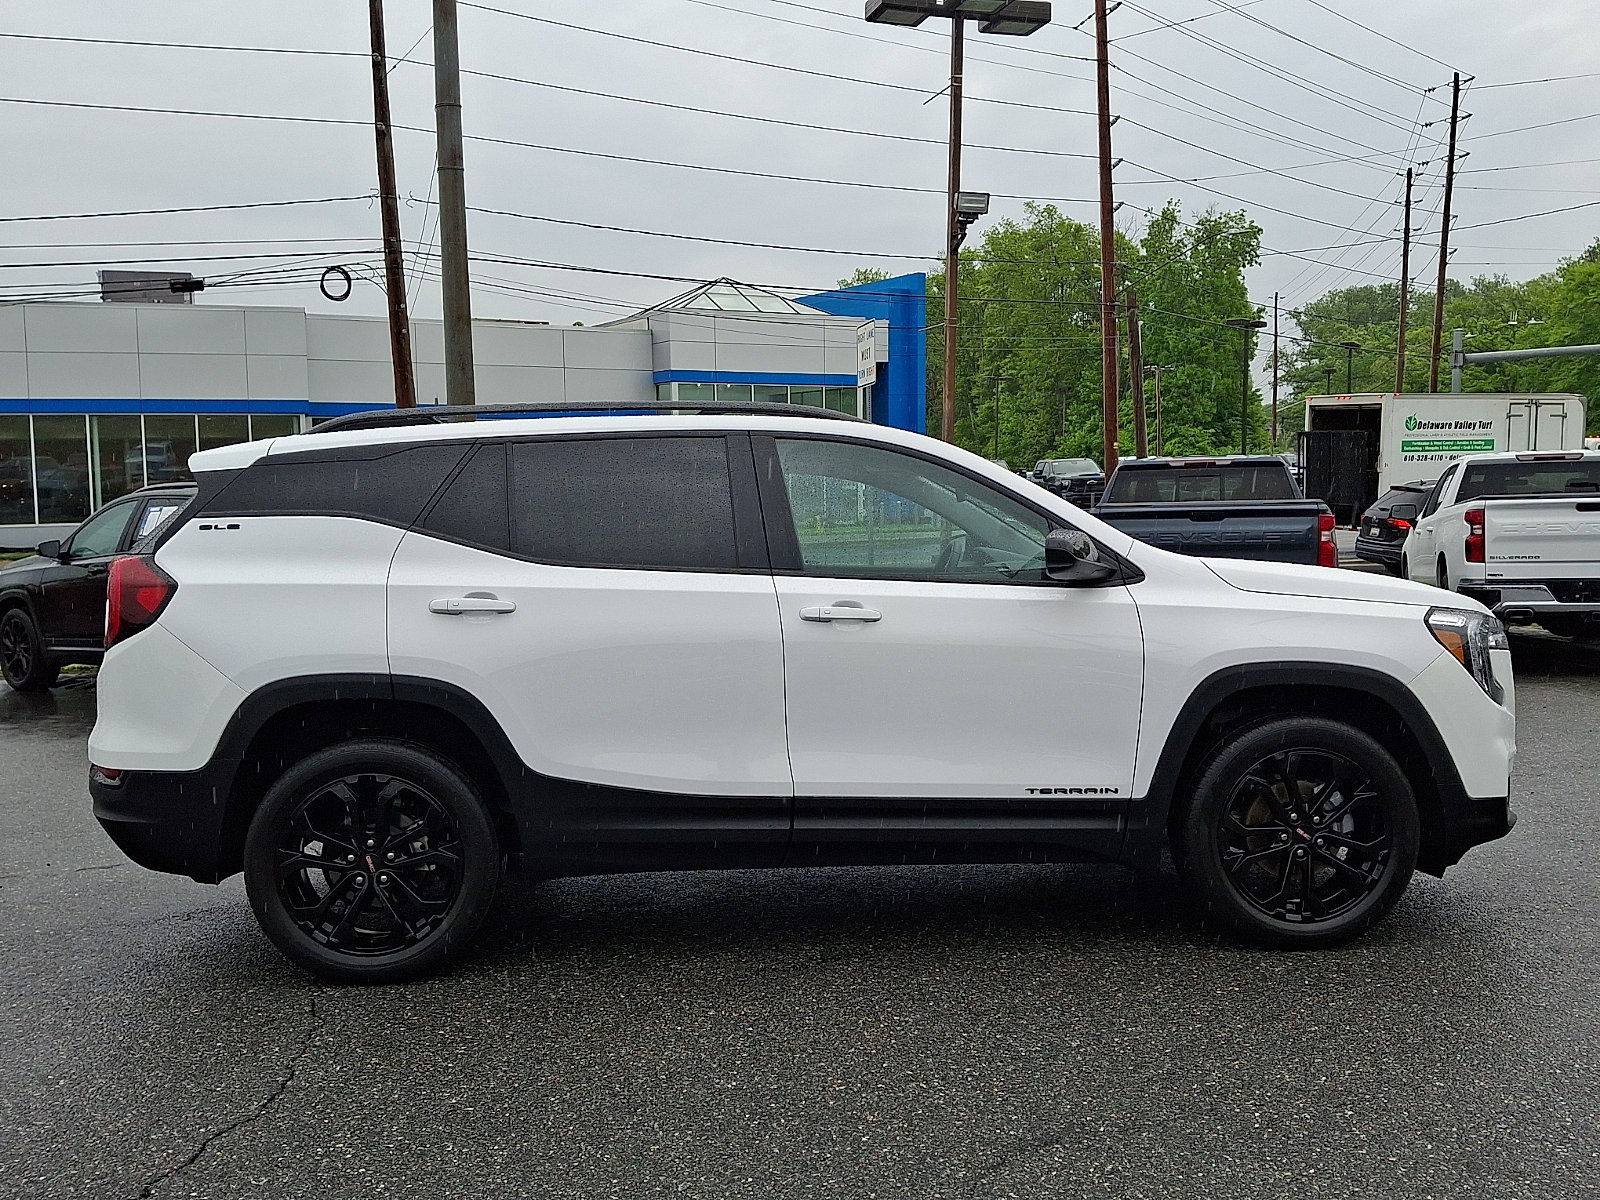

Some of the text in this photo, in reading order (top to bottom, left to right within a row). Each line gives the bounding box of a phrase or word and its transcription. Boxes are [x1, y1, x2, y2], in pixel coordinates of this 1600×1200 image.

[1417, 420, 1493, 431] Delaware Valley Turf
[1024, 787, 1119, 795] TERRAIN
